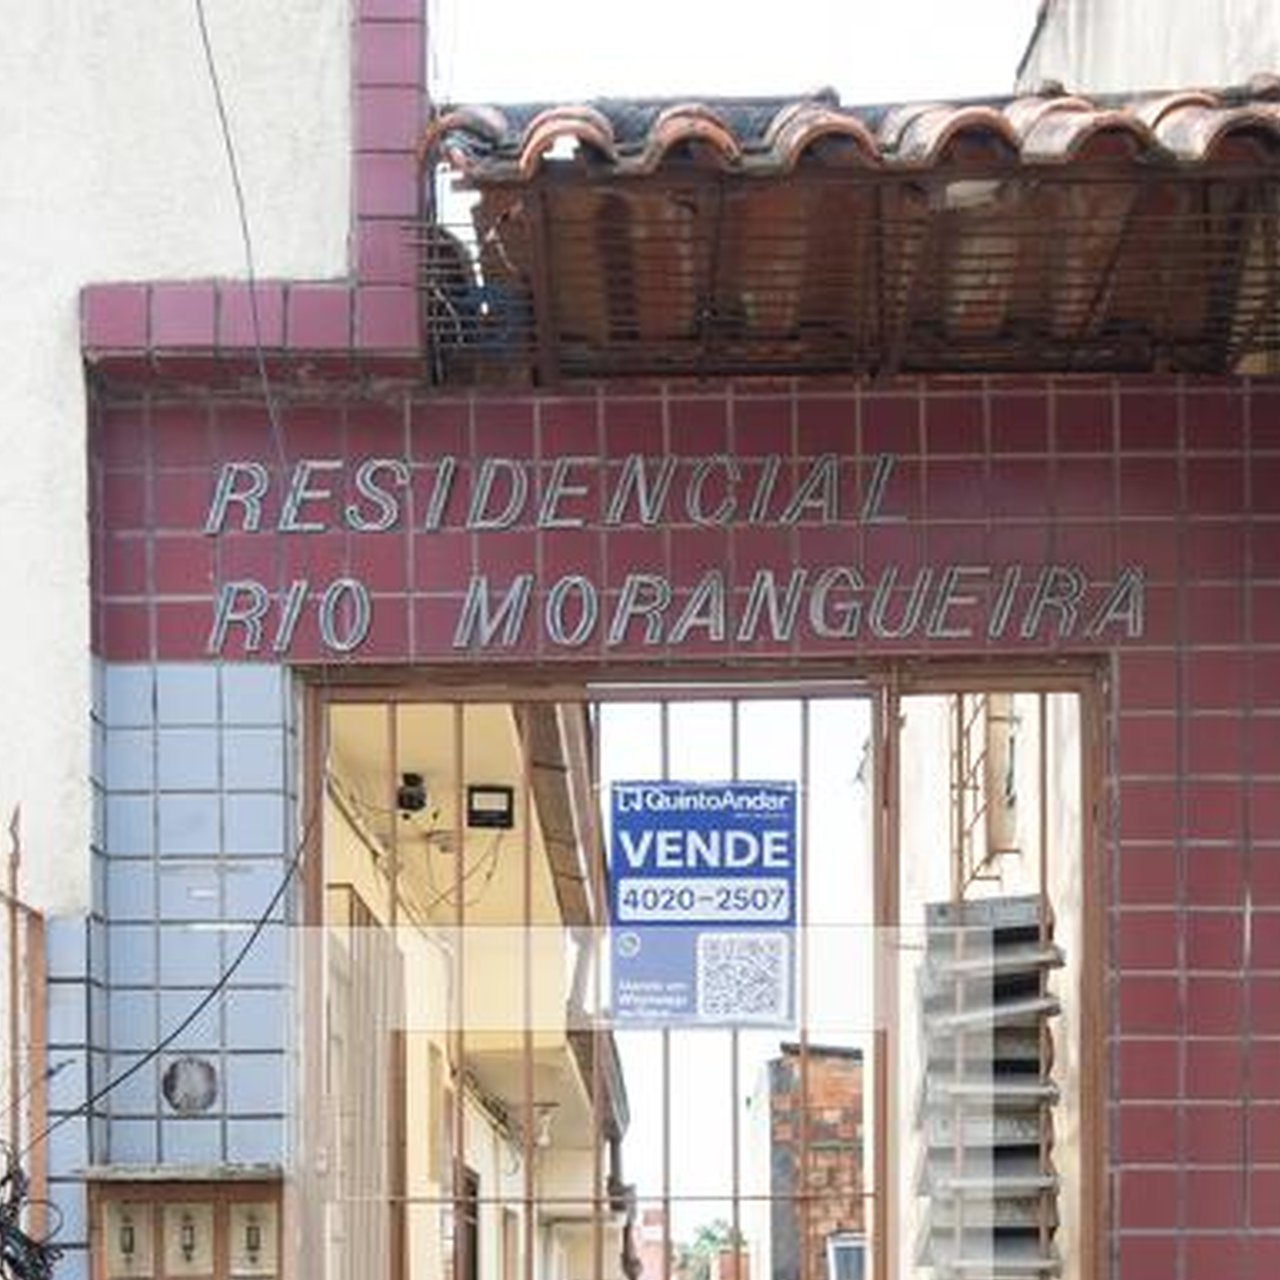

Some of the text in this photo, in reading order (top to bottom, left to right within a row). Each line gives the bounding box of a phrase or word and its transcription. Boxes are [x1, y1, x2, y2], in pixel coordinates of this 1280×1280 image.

[203, 453, 908, 534] RESIDENCIAL
[207, 564, 1146, 653] RIO MORANGUEIRA
[645, 789, 789, 812] QuintoAndar
[618, 830, 791, 868] VENDE
[622, 887, 785, 912] 4020-2507
